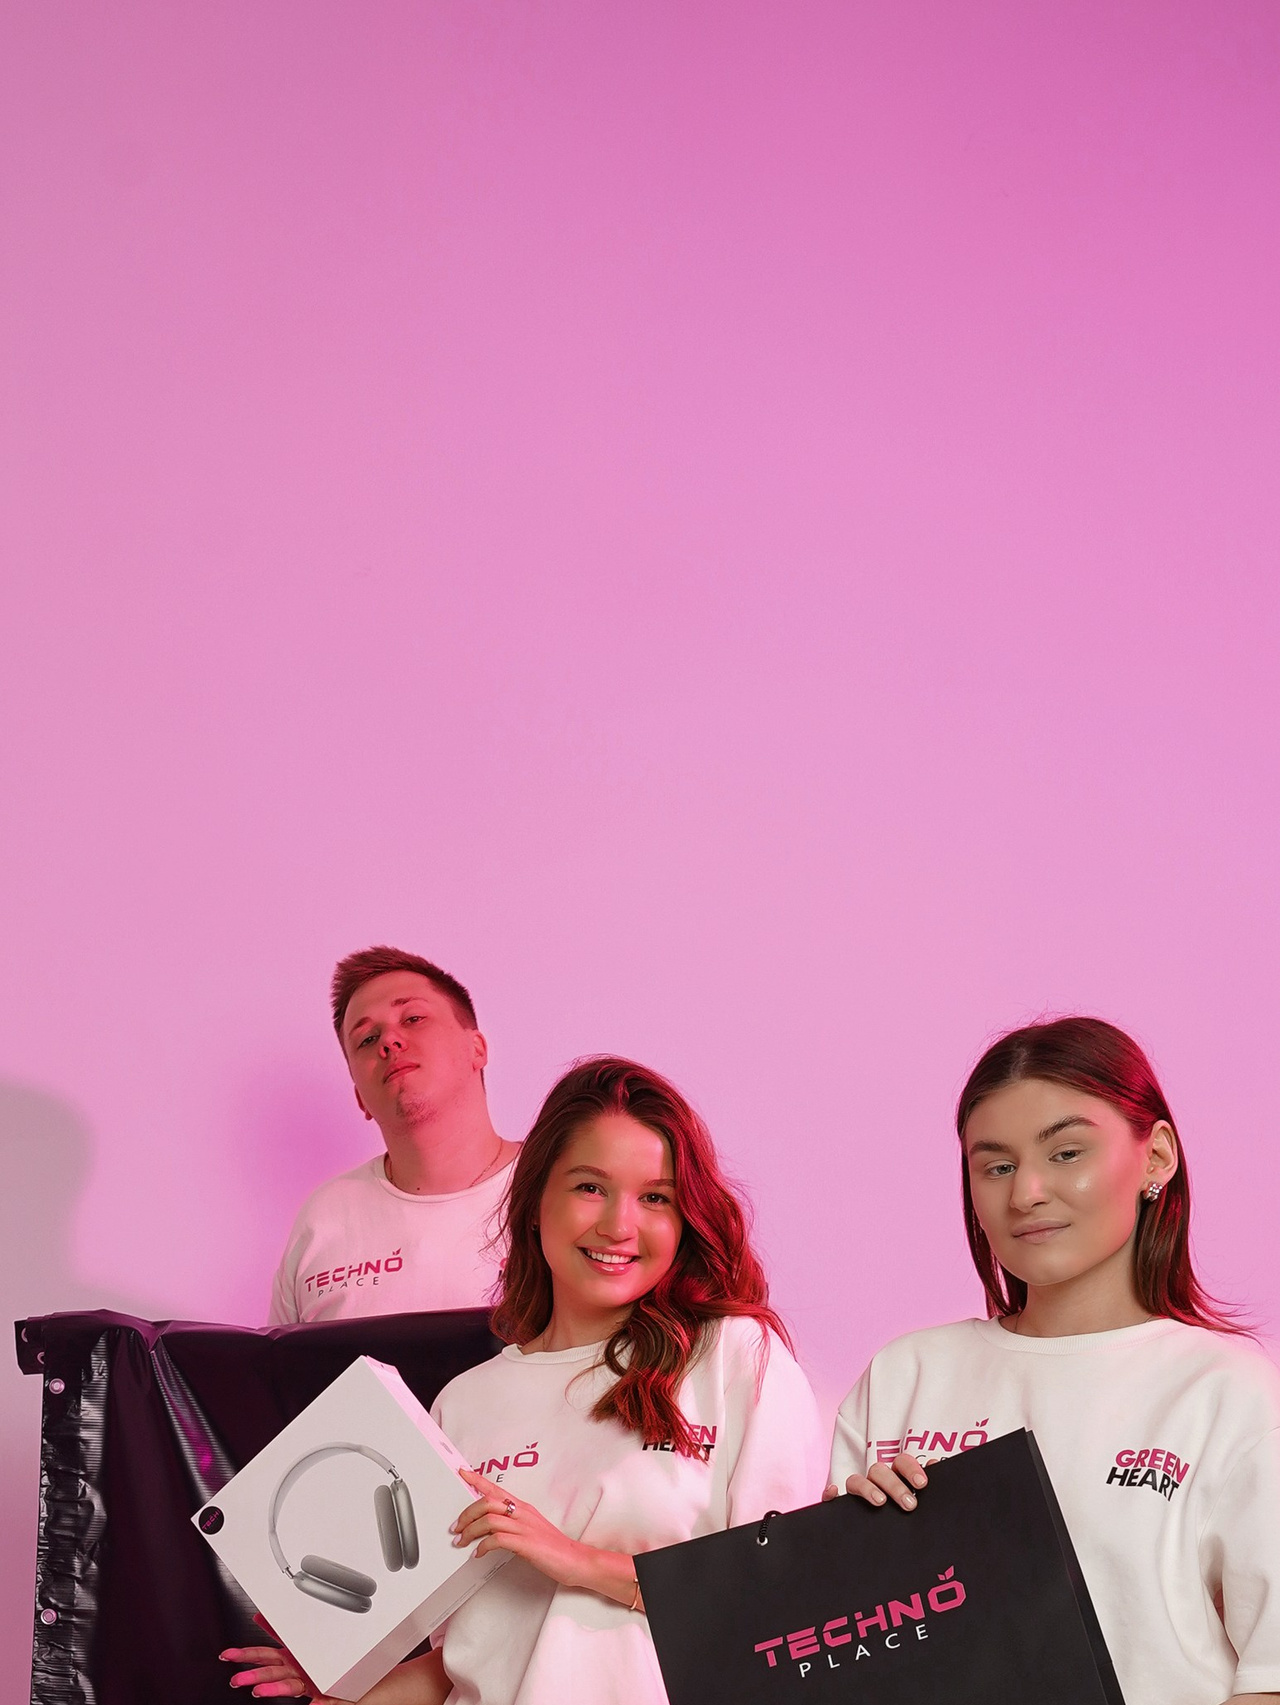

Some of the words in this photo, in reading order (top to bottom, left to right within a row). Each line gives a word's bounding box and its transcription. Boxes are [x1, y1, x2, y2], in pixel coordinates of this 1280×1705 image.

[317, 1276, 380, 1298] PLACE
[1105, 1466, 1180, 1502] HEART
[1115, 1448, 1191, 1485] GREEN
[798, 1623, 929, 1678] PLACE
